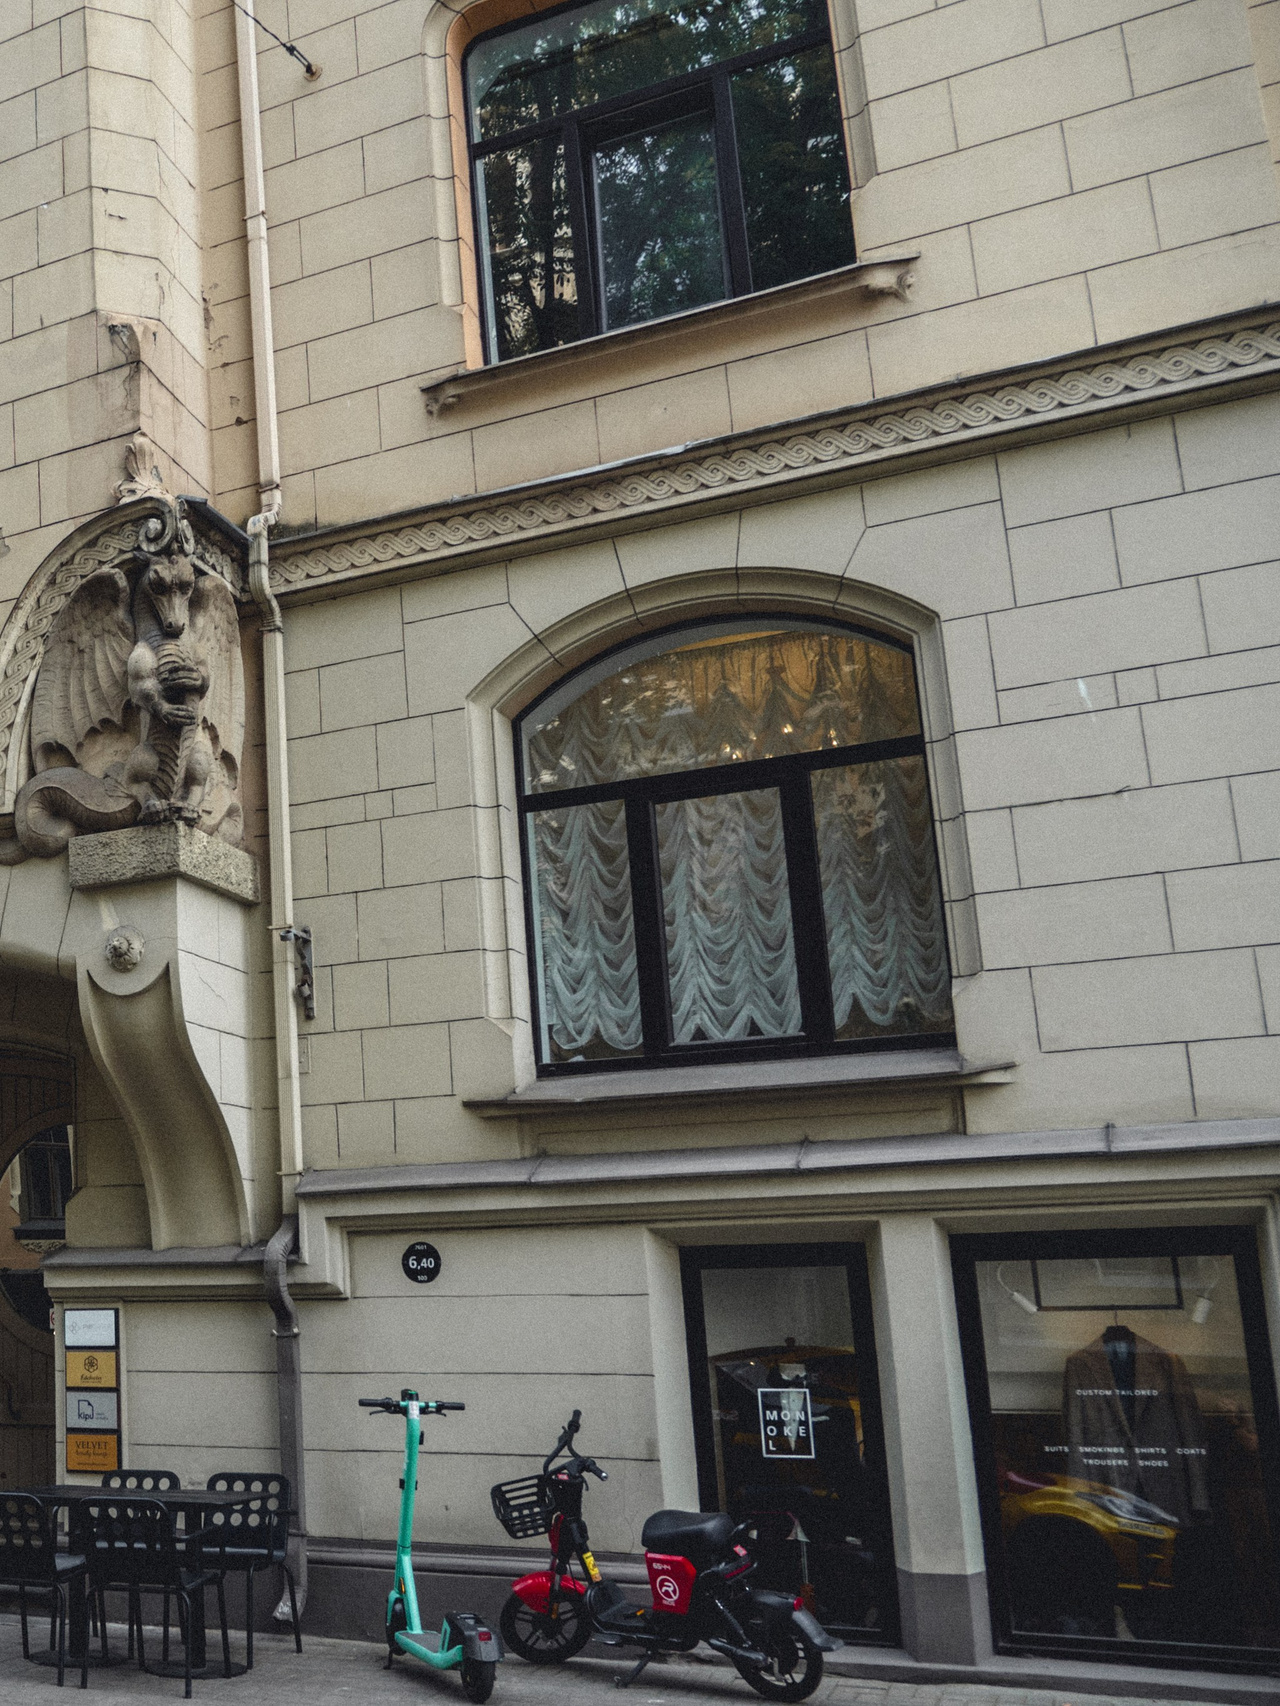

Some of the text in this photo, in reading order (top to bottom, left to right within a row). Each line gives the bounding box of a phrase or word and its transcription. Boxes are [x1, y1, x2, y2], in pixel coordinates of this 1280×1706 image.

[408, 1255, 435, 1270] 6,40
[75, 1441, 109, 1449] VELVET
[1083, 1458, 1129, 1466] TROUSERS
